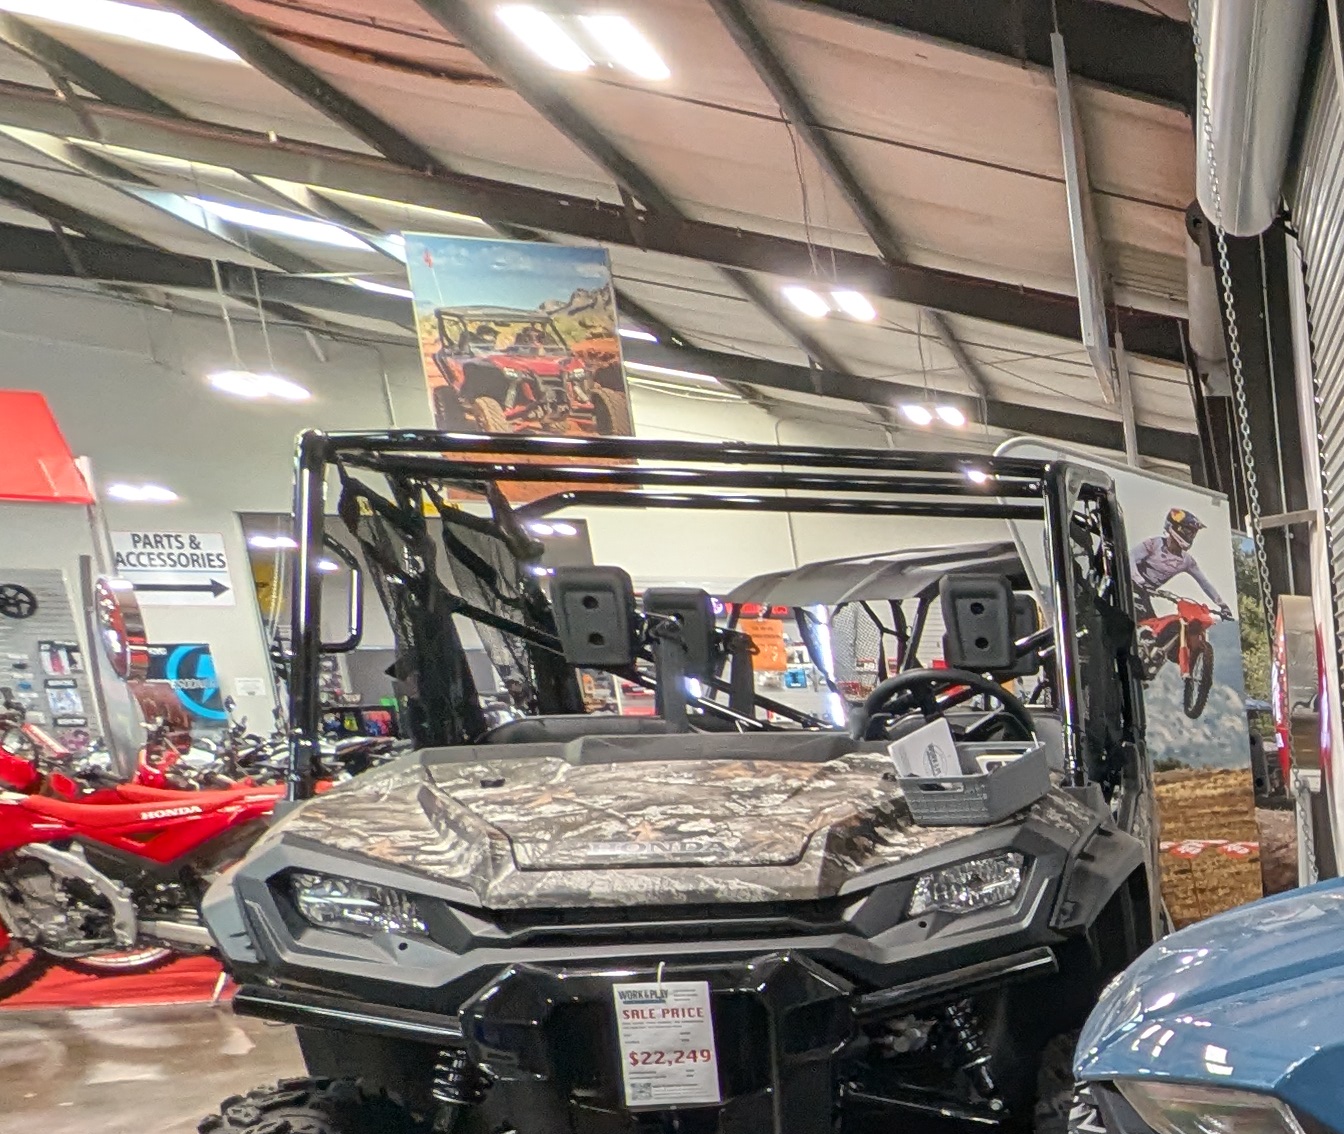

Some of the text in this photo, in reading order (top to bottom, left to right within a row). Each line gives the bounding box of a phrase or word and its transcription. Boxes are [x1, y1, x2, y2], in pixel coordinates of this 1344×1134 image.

[131, 533, 201, 550] PARTS &
[116, 552, 226, 569] ACCESSORIES
[141, 806, 203, 820] HONDA
[622, 1007, 705, 1020] SALE PRICE
[629, 1049, 711, 1067] $22,249
